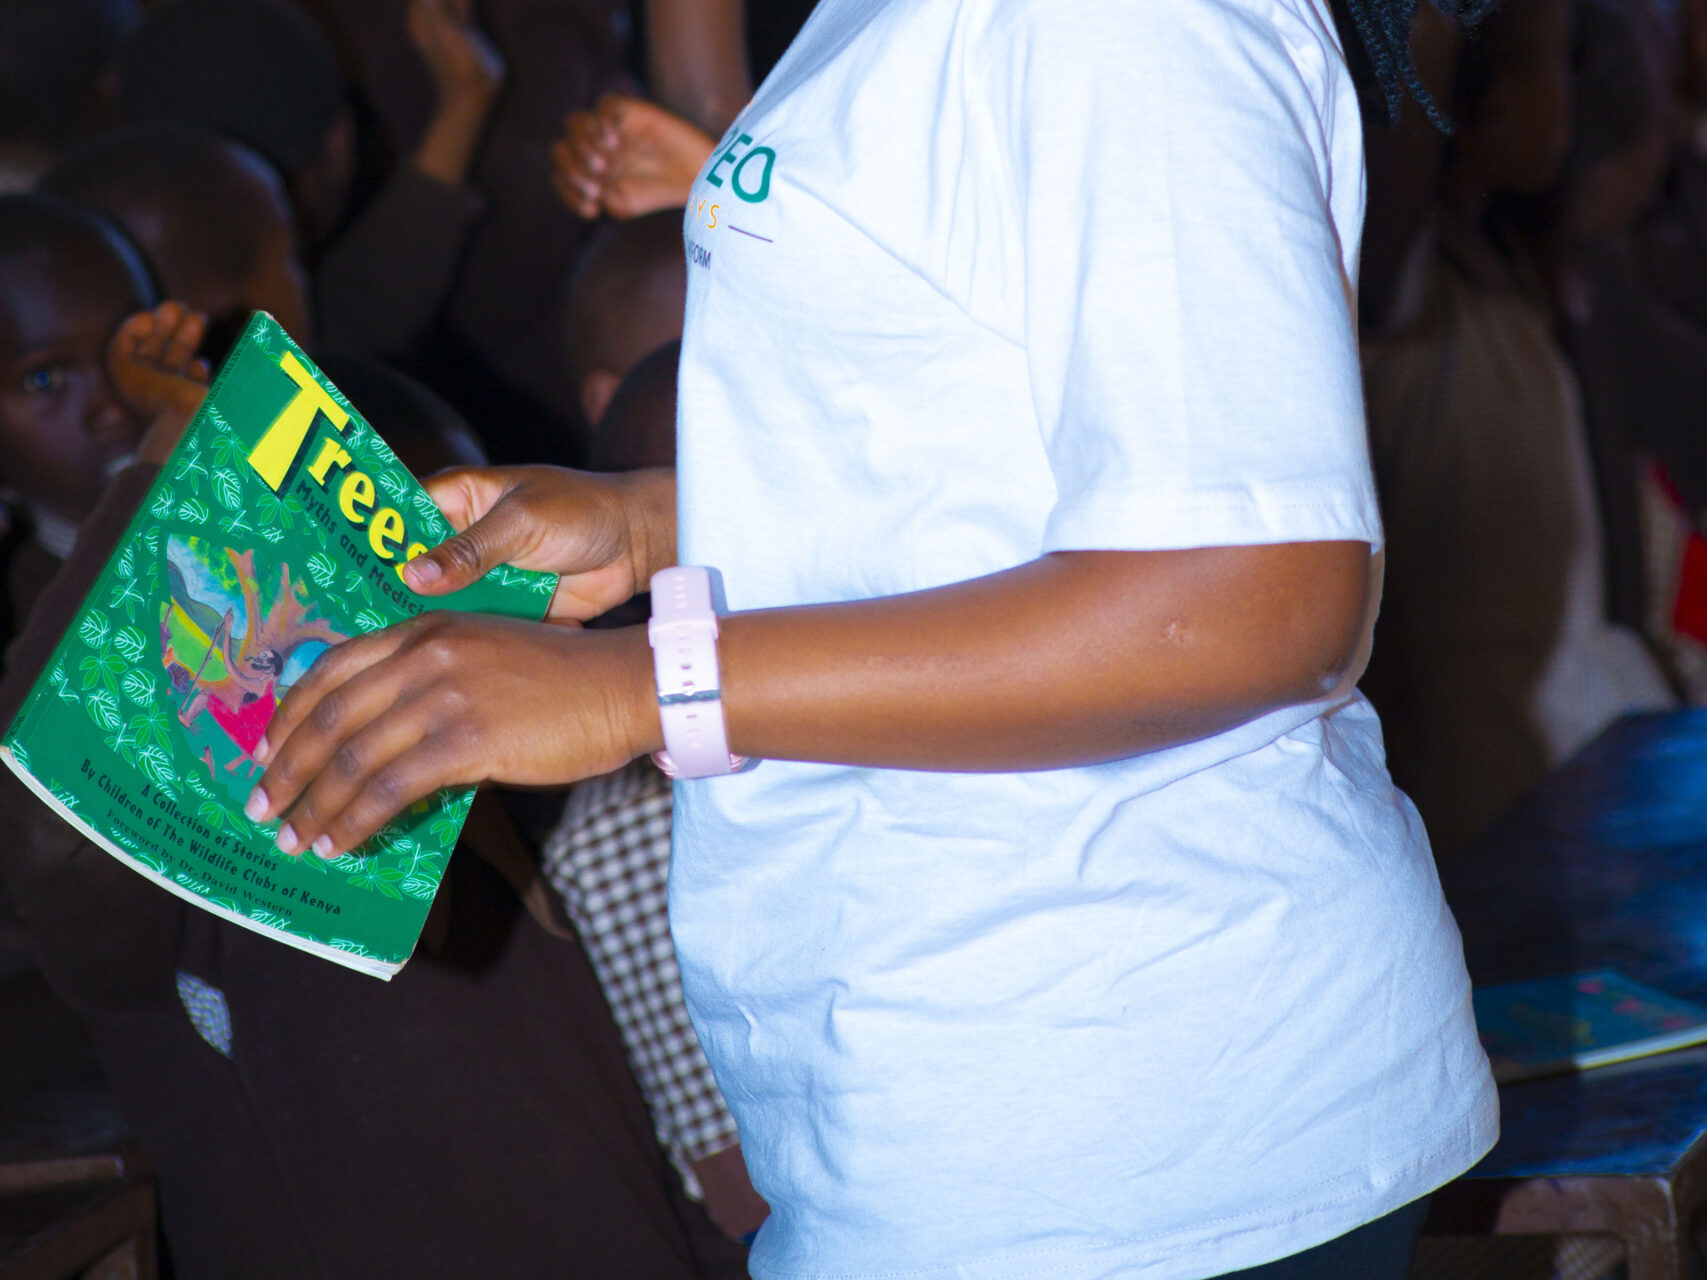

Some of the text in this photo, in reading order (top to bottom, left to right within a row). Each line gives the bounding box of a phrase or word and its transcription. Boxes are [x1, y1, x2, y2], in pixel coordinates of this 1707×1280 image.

[295, 479, 425, 615] Myths and Medici
[80, 757, 341, 916] By Children of The Wildlife Clubs of Kenya
[106, 809, 293, 916] Foreword by Dr. David Western
[141, 783, 278, 871] A Collection of Stories
